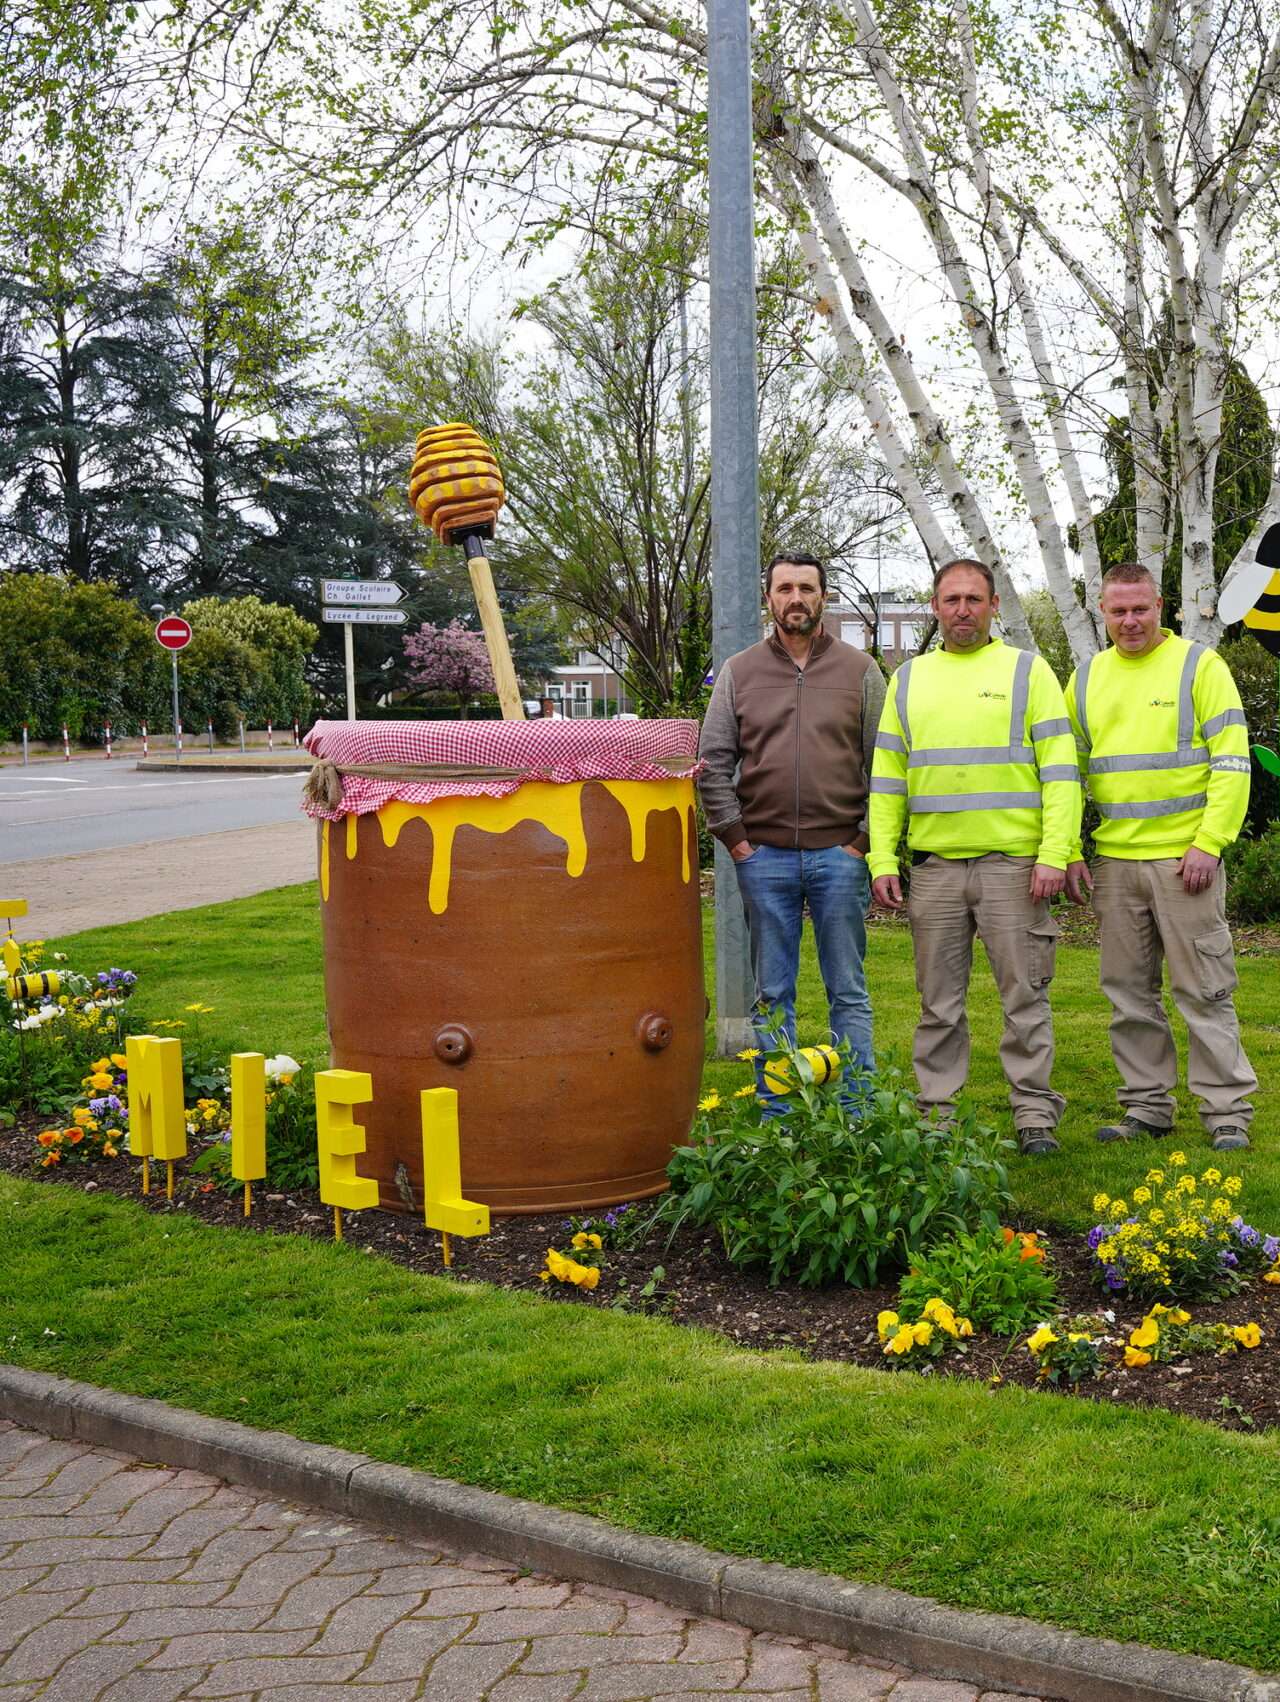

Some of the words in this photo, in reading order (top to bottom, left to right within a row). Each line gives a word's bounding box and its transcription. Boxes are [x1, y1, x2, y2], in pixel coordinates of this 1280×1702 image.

[327, 583, 355, 592] Groupe
[359, 584, 392, 593] Scolaire
[345, 593, 371, 601] Gallet
[327, 611, 352, 620] Lycée
[366, 612, 398, 621] Legrand
[126, 1035, 490, 1238] MIEL
